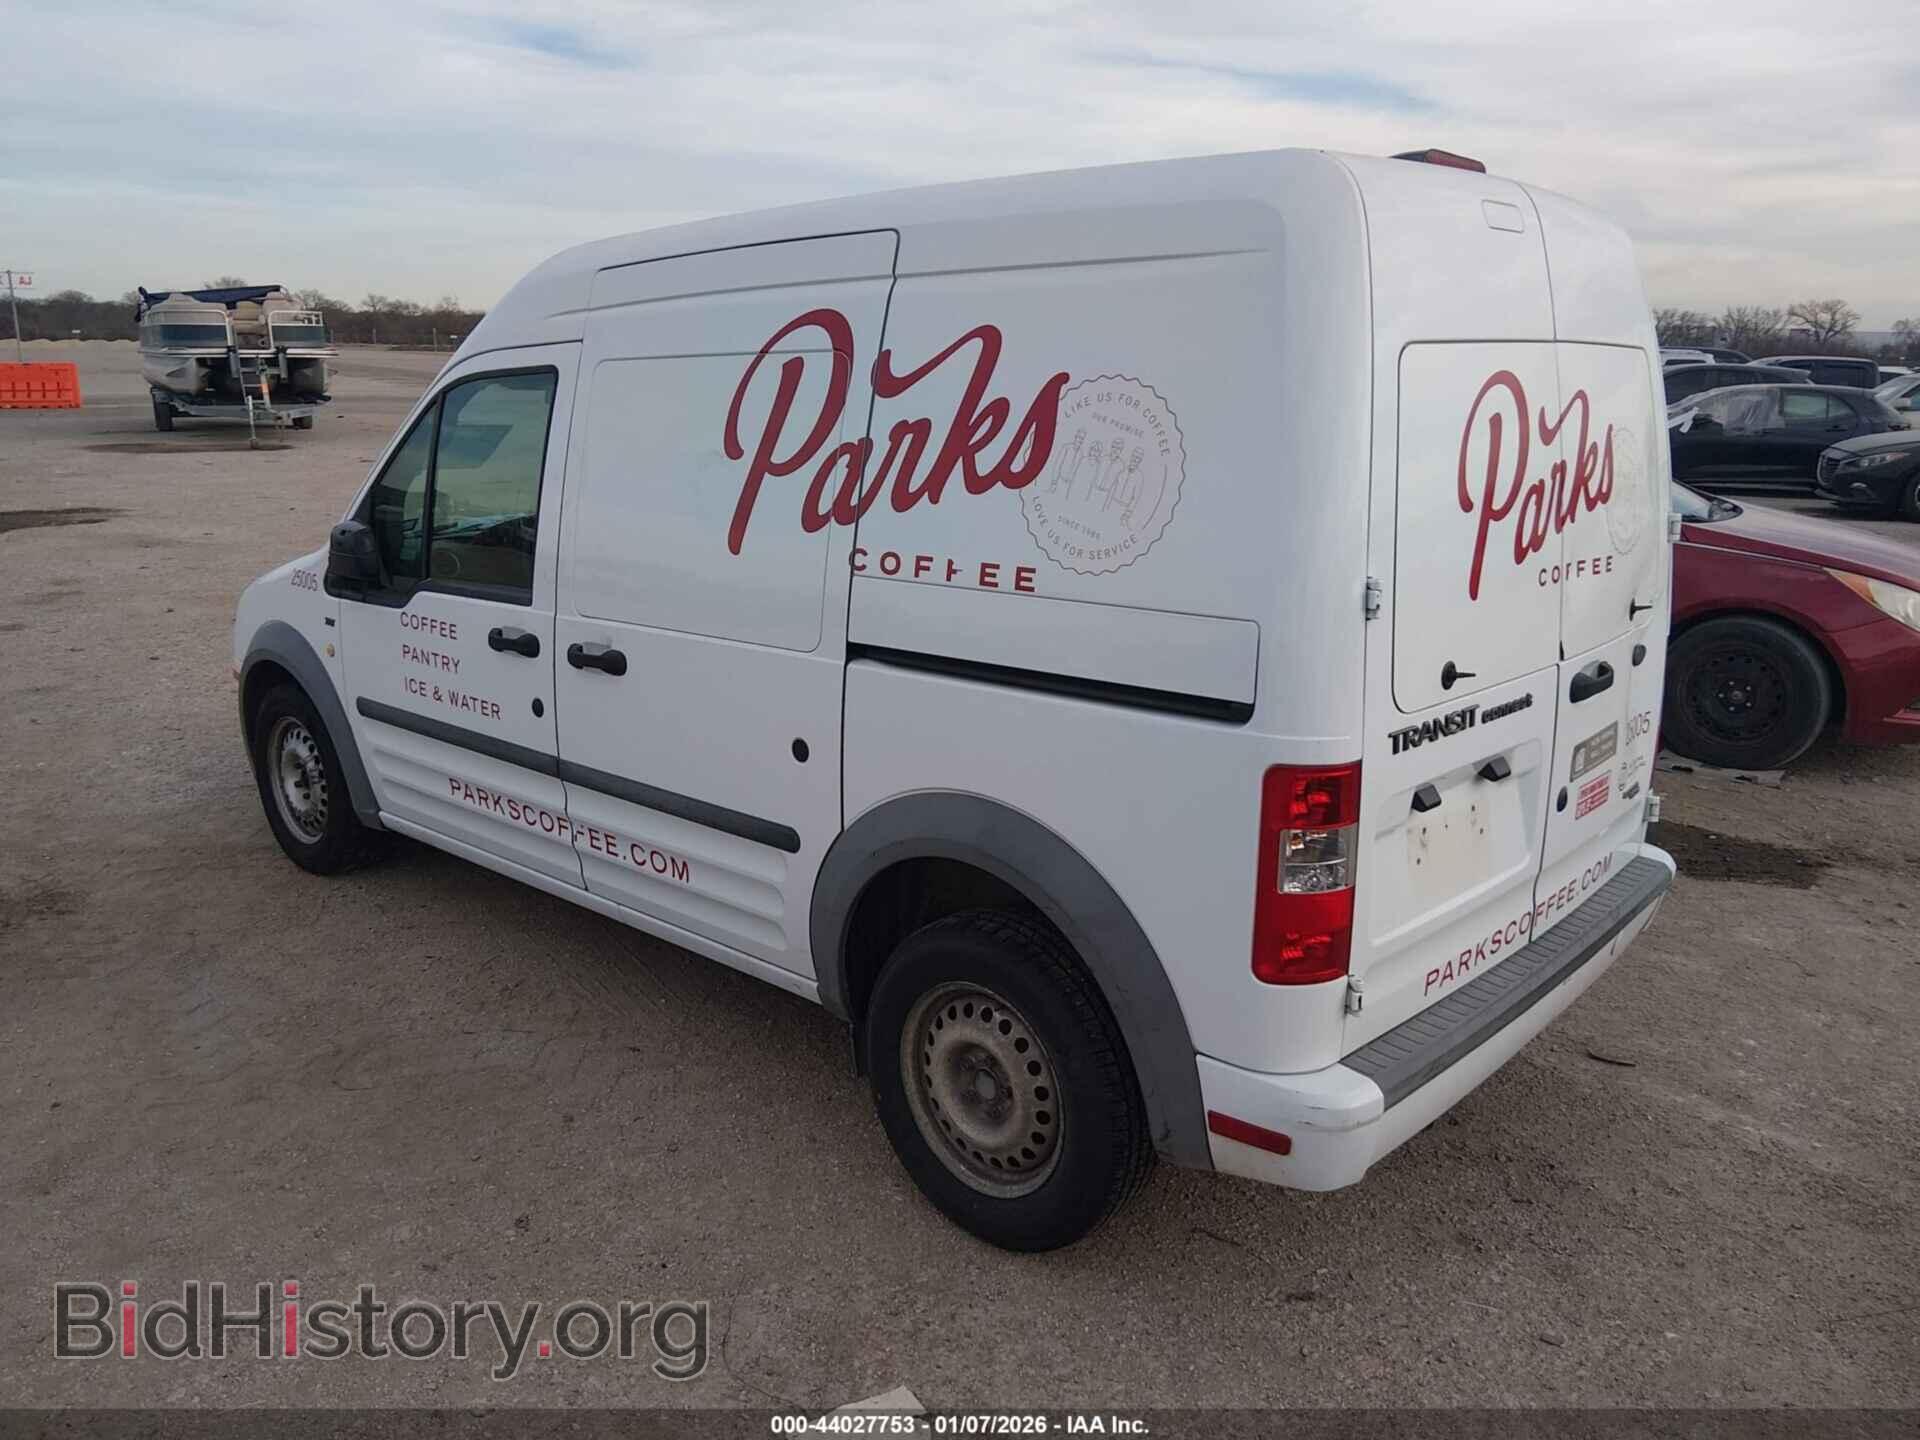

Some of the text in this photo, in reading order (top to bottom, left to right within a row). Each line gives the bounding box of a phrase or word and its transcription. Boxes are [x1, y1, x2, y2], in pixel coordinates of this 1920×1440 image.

[723, 308, 1070, 555] Parks
[1064, 392, 1171, 457] LIKE US FOR COFFEE
[1457, 369, 1615, 602] Parks
[1033, 496, 1138, 561] LOVE US FOR SERVICE
[848, 547, 1038, 593] COFFEE
[1537, 555, 1614, 587] COFFEE
[400, 611, 458, 641] COFFEE
[402, 644, 461, 674] PANTRY
[404, 676, 501, 721] ICE & WATER
[1387, 703, 1481, 756] TRANSIT
[448, 778, 691, 884] PARKSCOFFEE.COM
[1423, 852, 1614, 998] PARKSCOFFEE.COM
